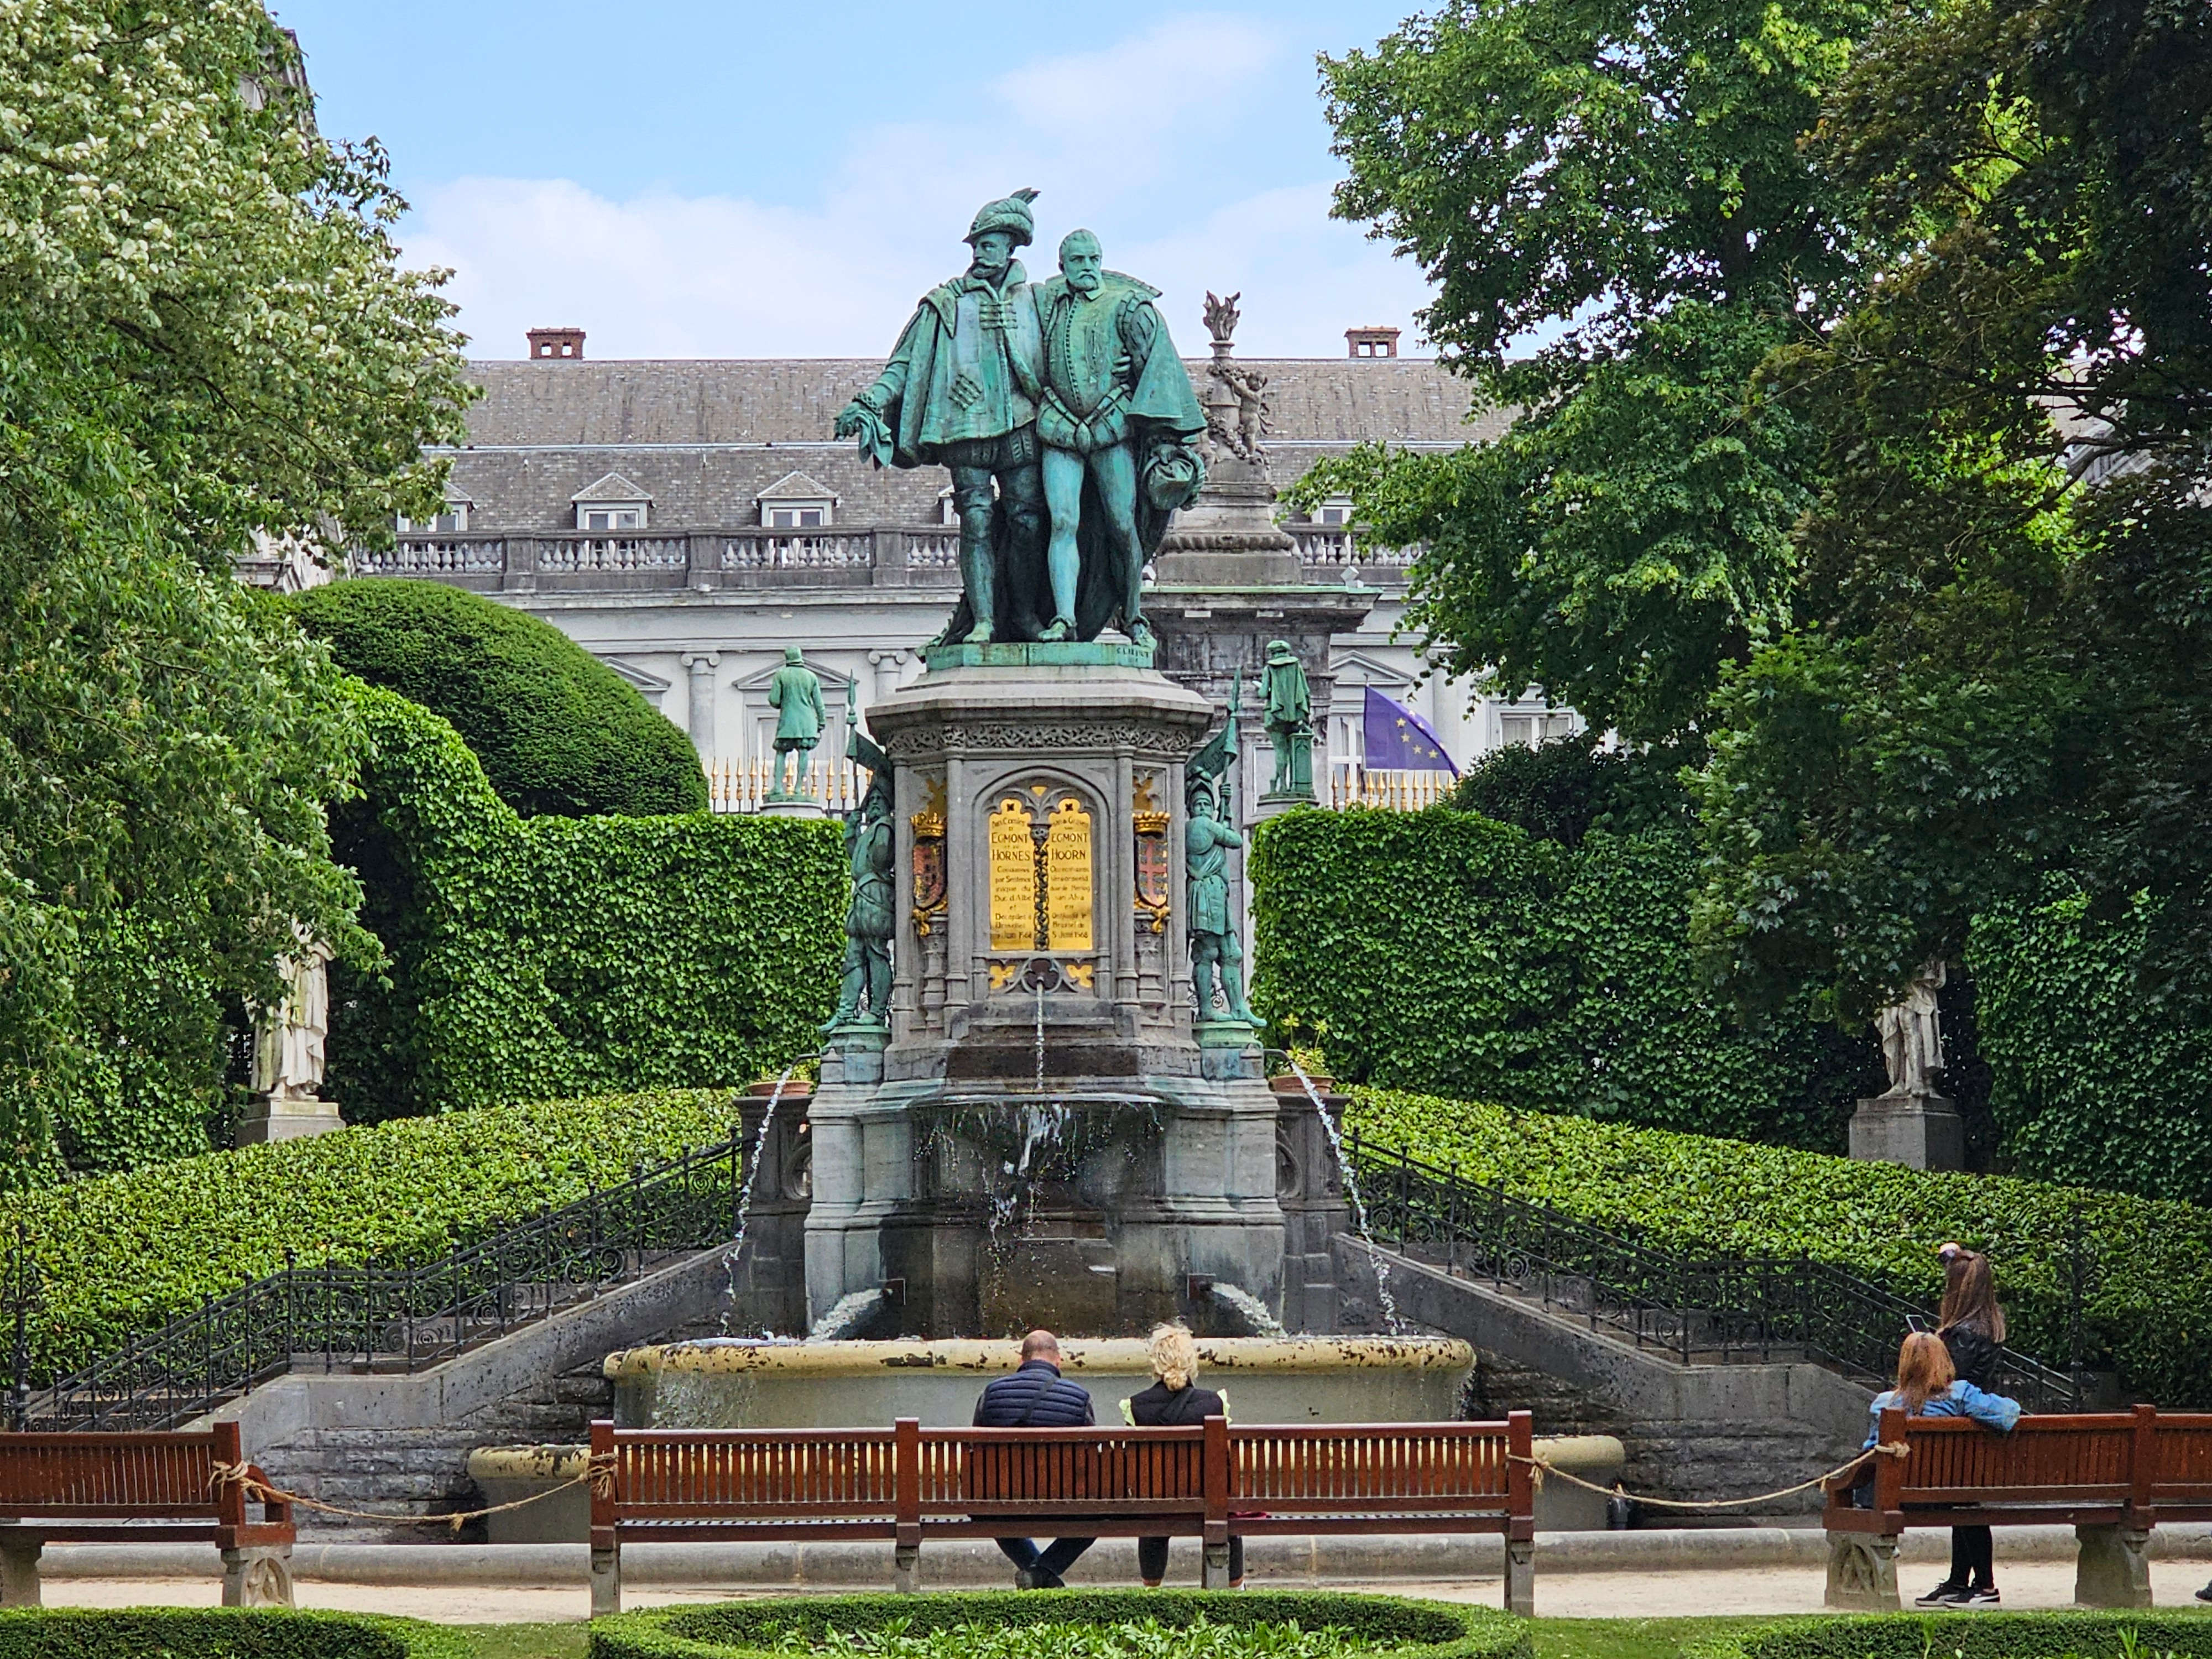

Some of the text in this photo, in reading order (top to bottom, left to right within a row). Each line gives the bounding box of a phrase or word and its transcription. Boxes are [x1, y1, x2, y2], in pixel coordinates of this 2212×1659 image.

[992, 832, 1027, 843] EGMONT
[1051, 833, 1088, 843] EGMONT
[992, 849, 1030, 861] HORNES
[1051, 848, 1086, 860] HOORN
